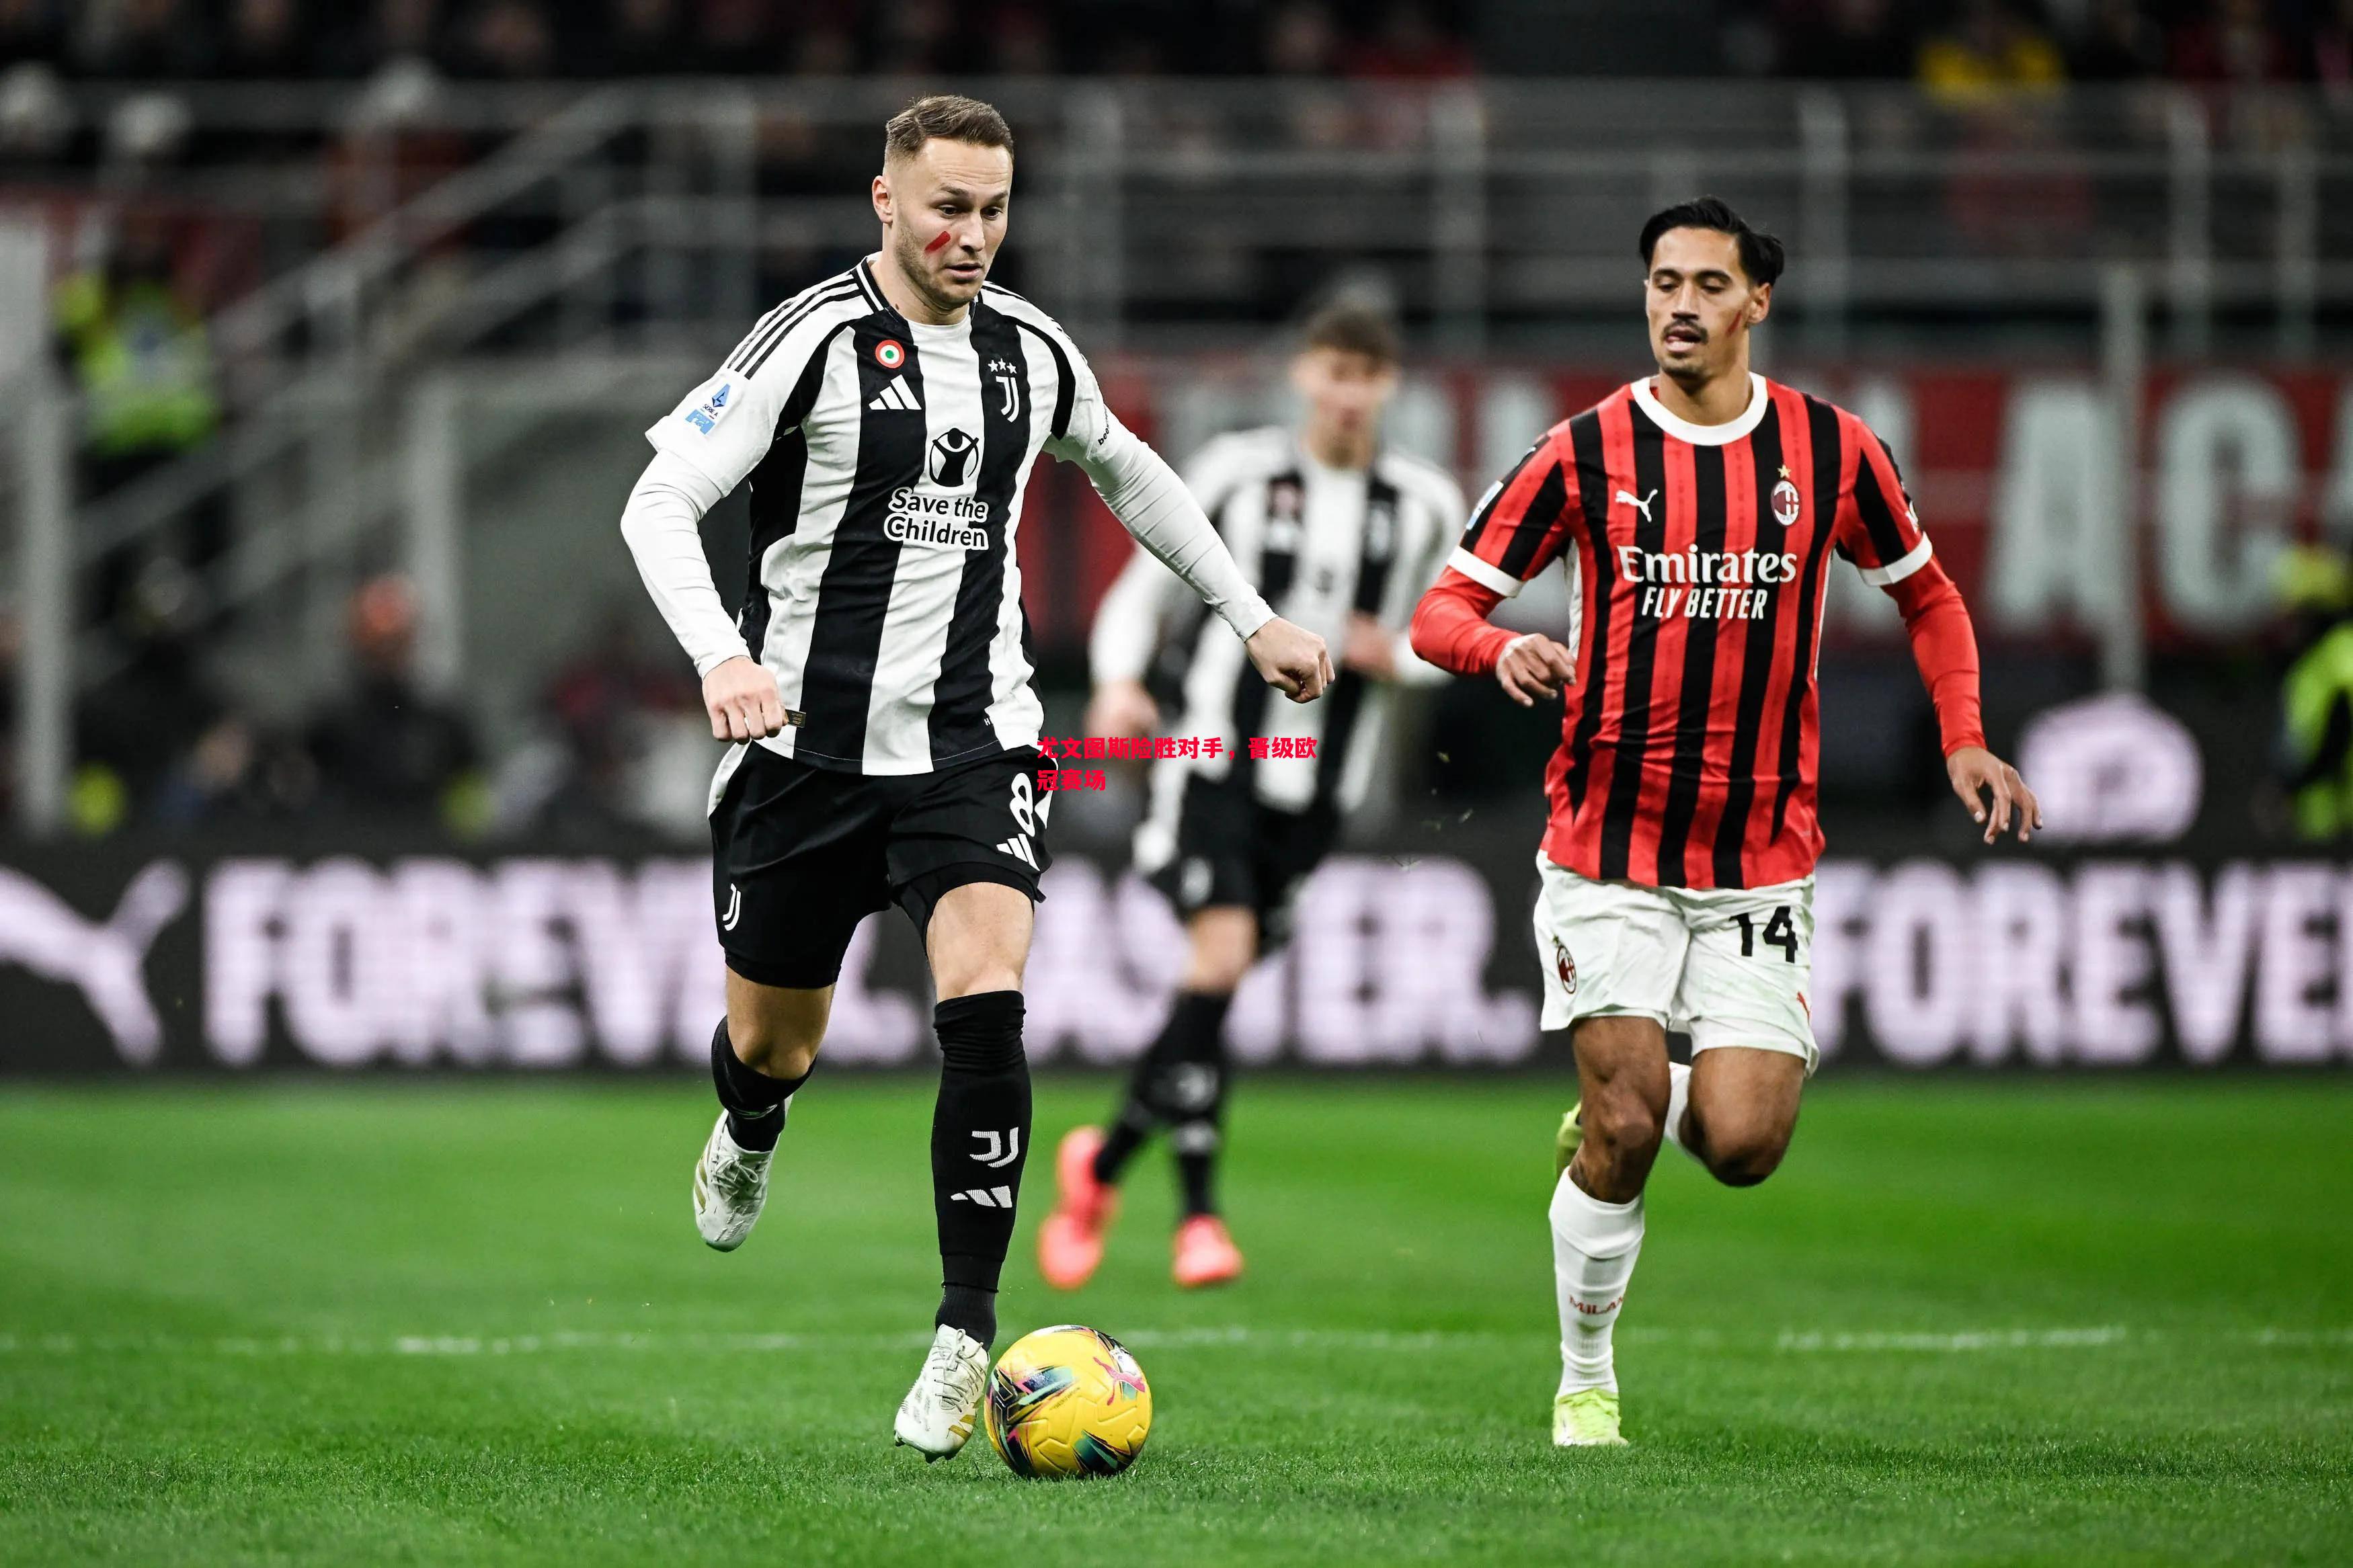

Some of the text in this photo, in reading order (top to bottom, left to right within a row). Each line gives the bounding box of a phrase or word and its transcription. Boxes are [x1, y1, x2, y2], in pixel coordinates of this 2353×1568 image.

[891, 488, 986, 519] Save the
[887, 515, 986, 547] Children
[1617, 544, 1798, 583] Emirates
[1641, 586, 1768, 620] FLY BETTER
[1010, 773, 1036, 837] 8
[1730, 906, 1798, 963] 14
